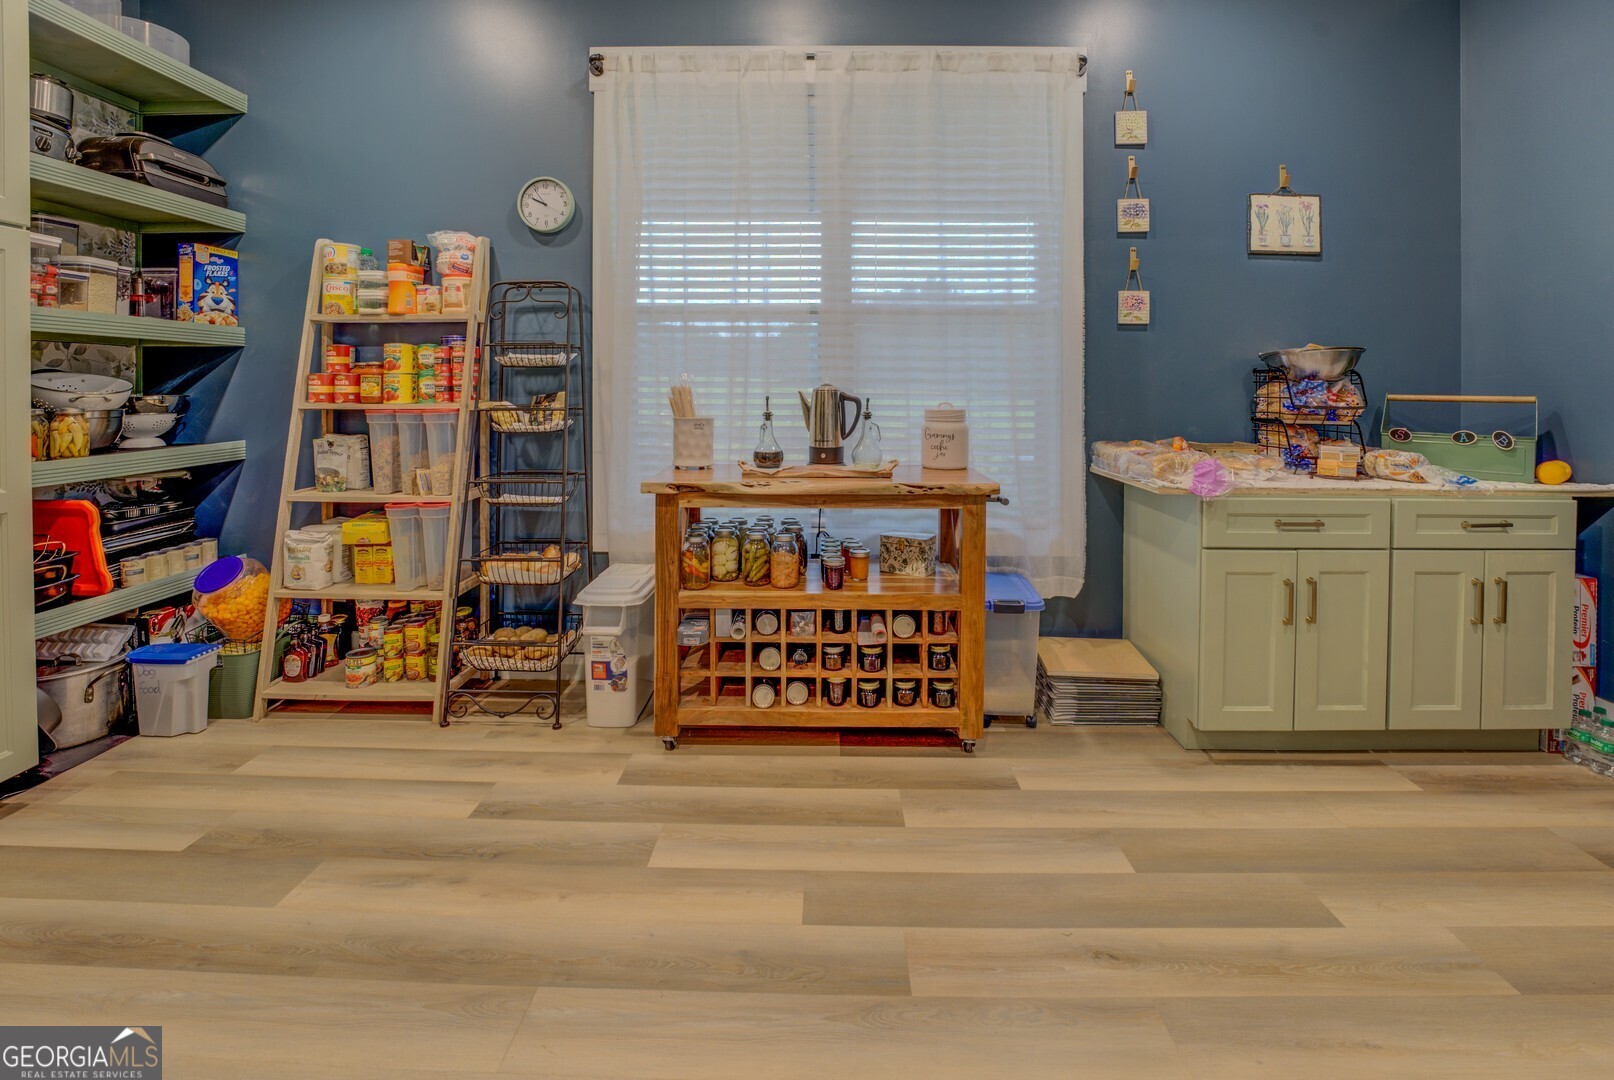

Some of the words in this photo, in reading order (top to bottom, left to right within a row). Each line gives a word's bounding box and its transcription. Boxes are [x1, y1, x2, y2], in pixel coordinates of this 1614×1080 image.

[325, 283, 349, 293] Crisco
[1395, 430, 1405, 440] S
[1460, 432, 1469, 443] A
[1497, 435, 1508, 447] B
[1581, 604, 1589, 638] Premier
[136, 664, 156, 680] Dog
[139, 679, 161, 695] food
